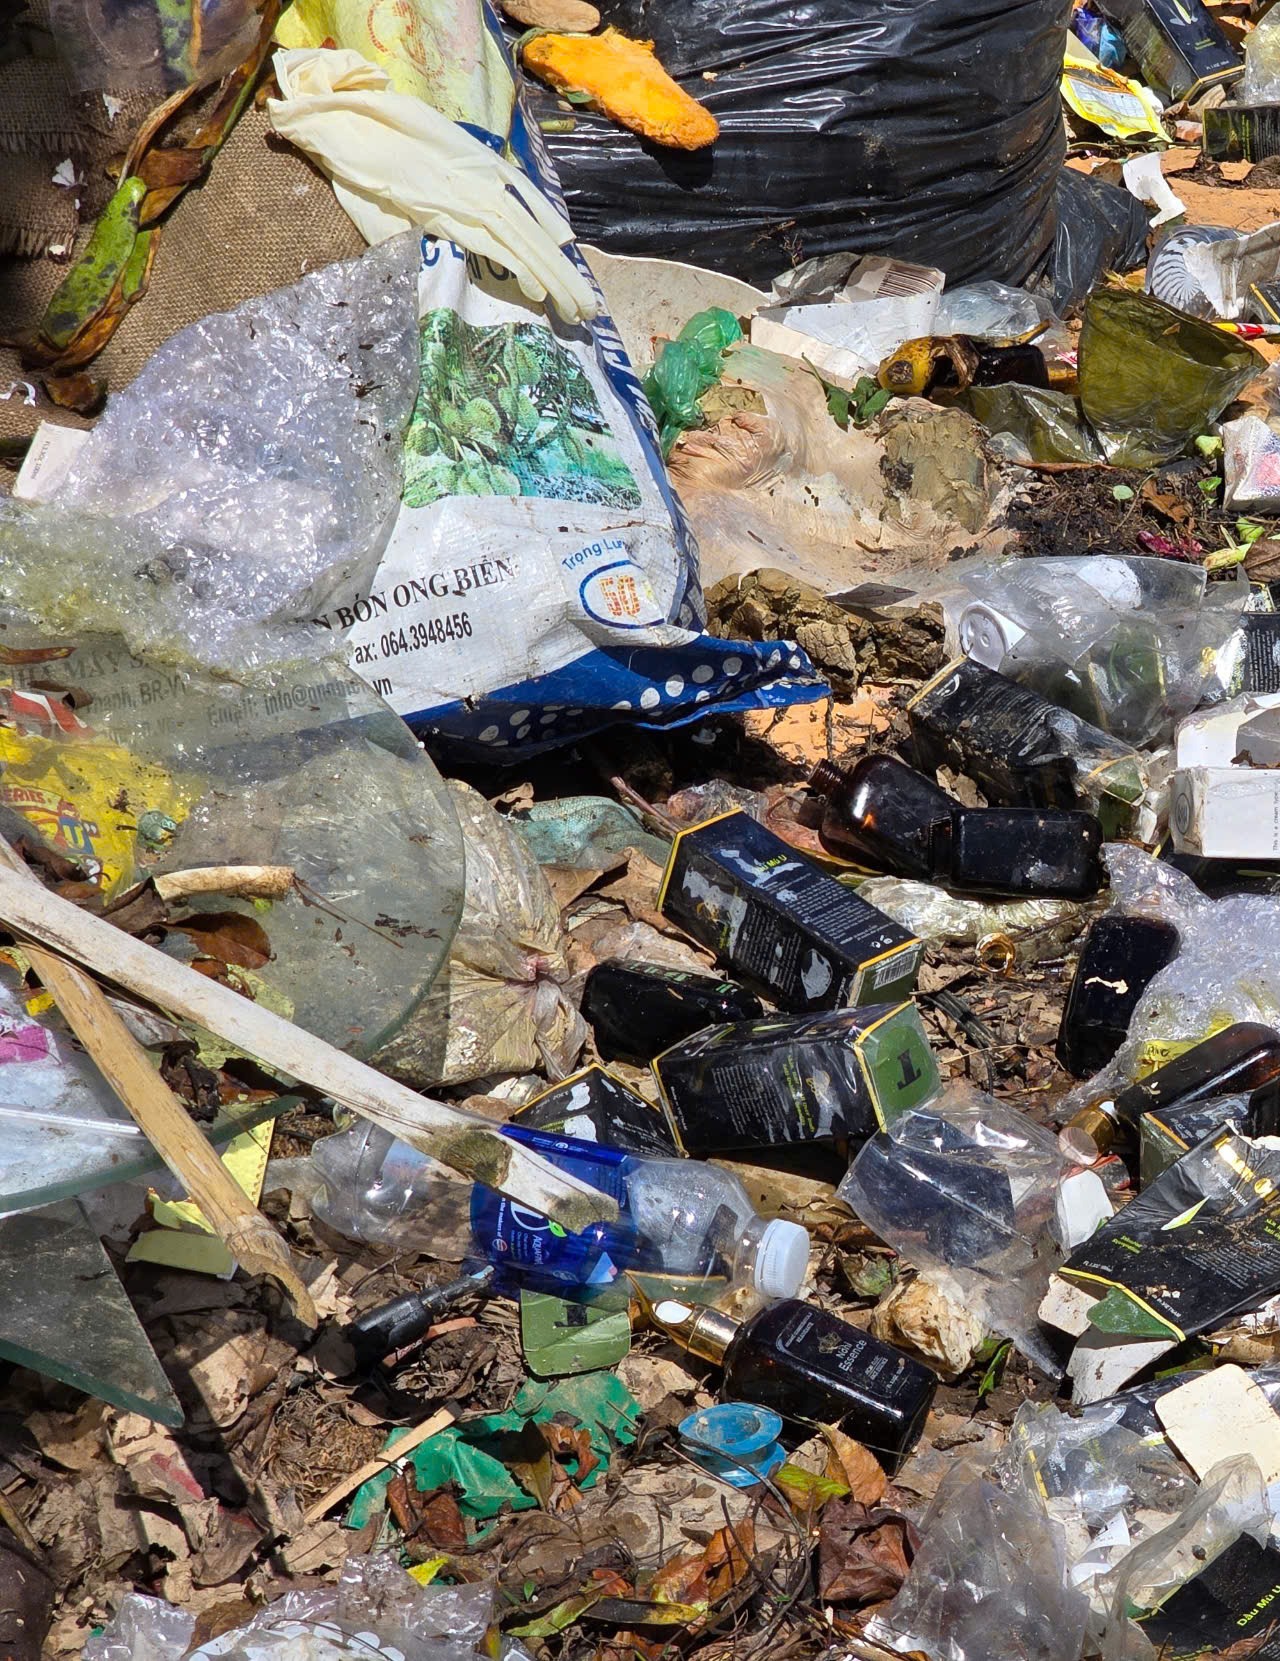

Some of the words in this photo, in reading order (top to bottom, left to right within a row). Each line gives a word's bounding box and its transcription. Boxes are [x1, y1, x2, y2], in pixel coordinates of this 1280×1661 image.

[562, 544, 602, 572] Trọng
[339, 593, 389, 630] BÓN
[393, 573, 449, 608] ONG
[354, 641, 378, 665] ax:
[380, 611, 473, 657] 064.3948456
[2, 787, 45, 806] ERIES
[838, 1338, 868, 1372] Essence
[1256, 1593, 1275, 1609] Mù
